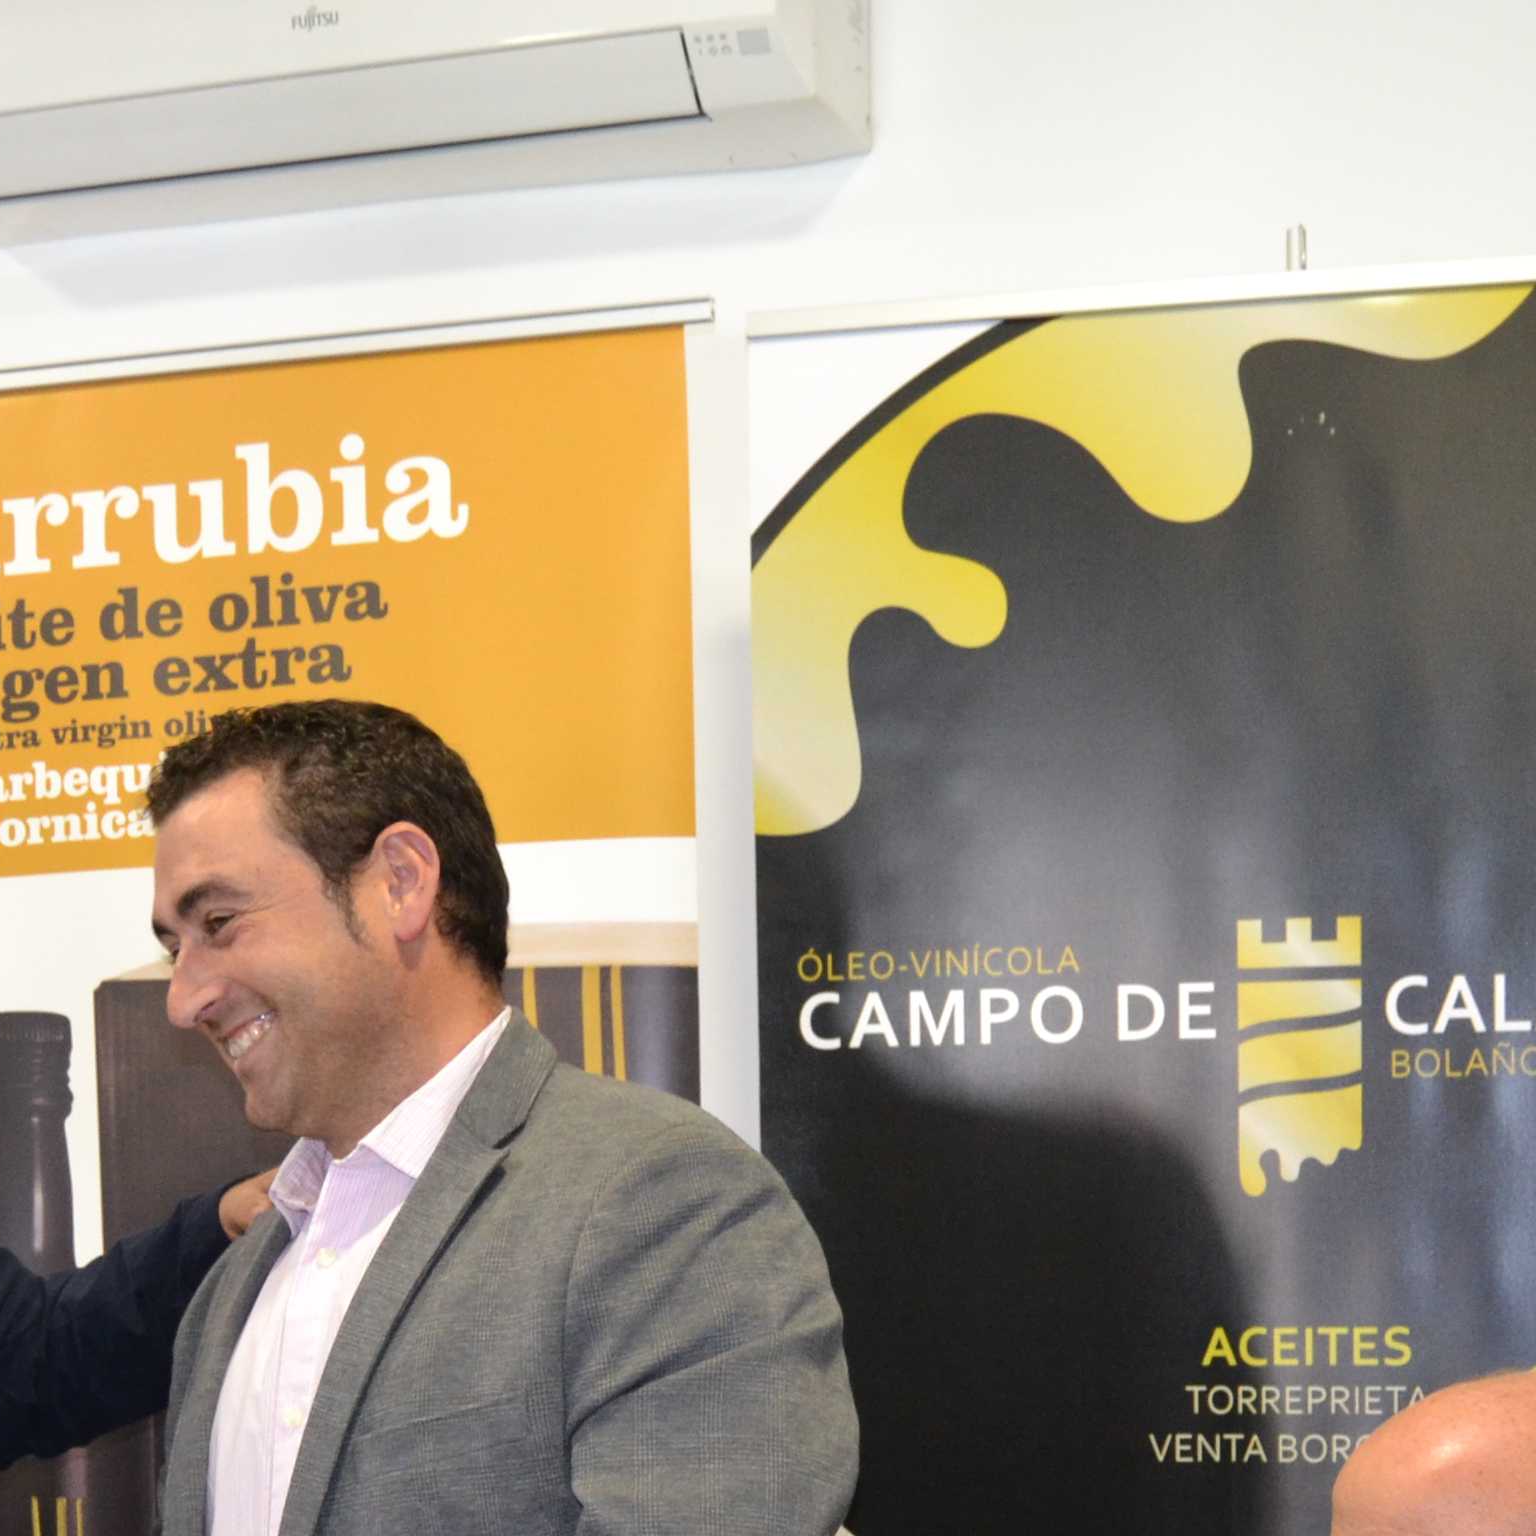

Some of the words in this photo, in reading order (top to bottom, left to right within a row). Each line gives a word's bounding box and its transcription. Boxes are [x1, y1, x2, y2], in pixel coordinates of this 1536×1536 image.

[99, 587, 184, 641] de
[209, 573, 388, 633] oliva
[154, 635, 352, 695] extra
[52, 715, 152, 748] virgin
[797, 942, 1081, 983] ÓLEO-VINÍCOLA
[797, 984, 1084, 1051] CAMPO
[1116, 981, 1217, 1042] DE
[1201, 1325, 1413, 1367] ACEITES
[1148, 1432, 1268, 1463] VENTA
